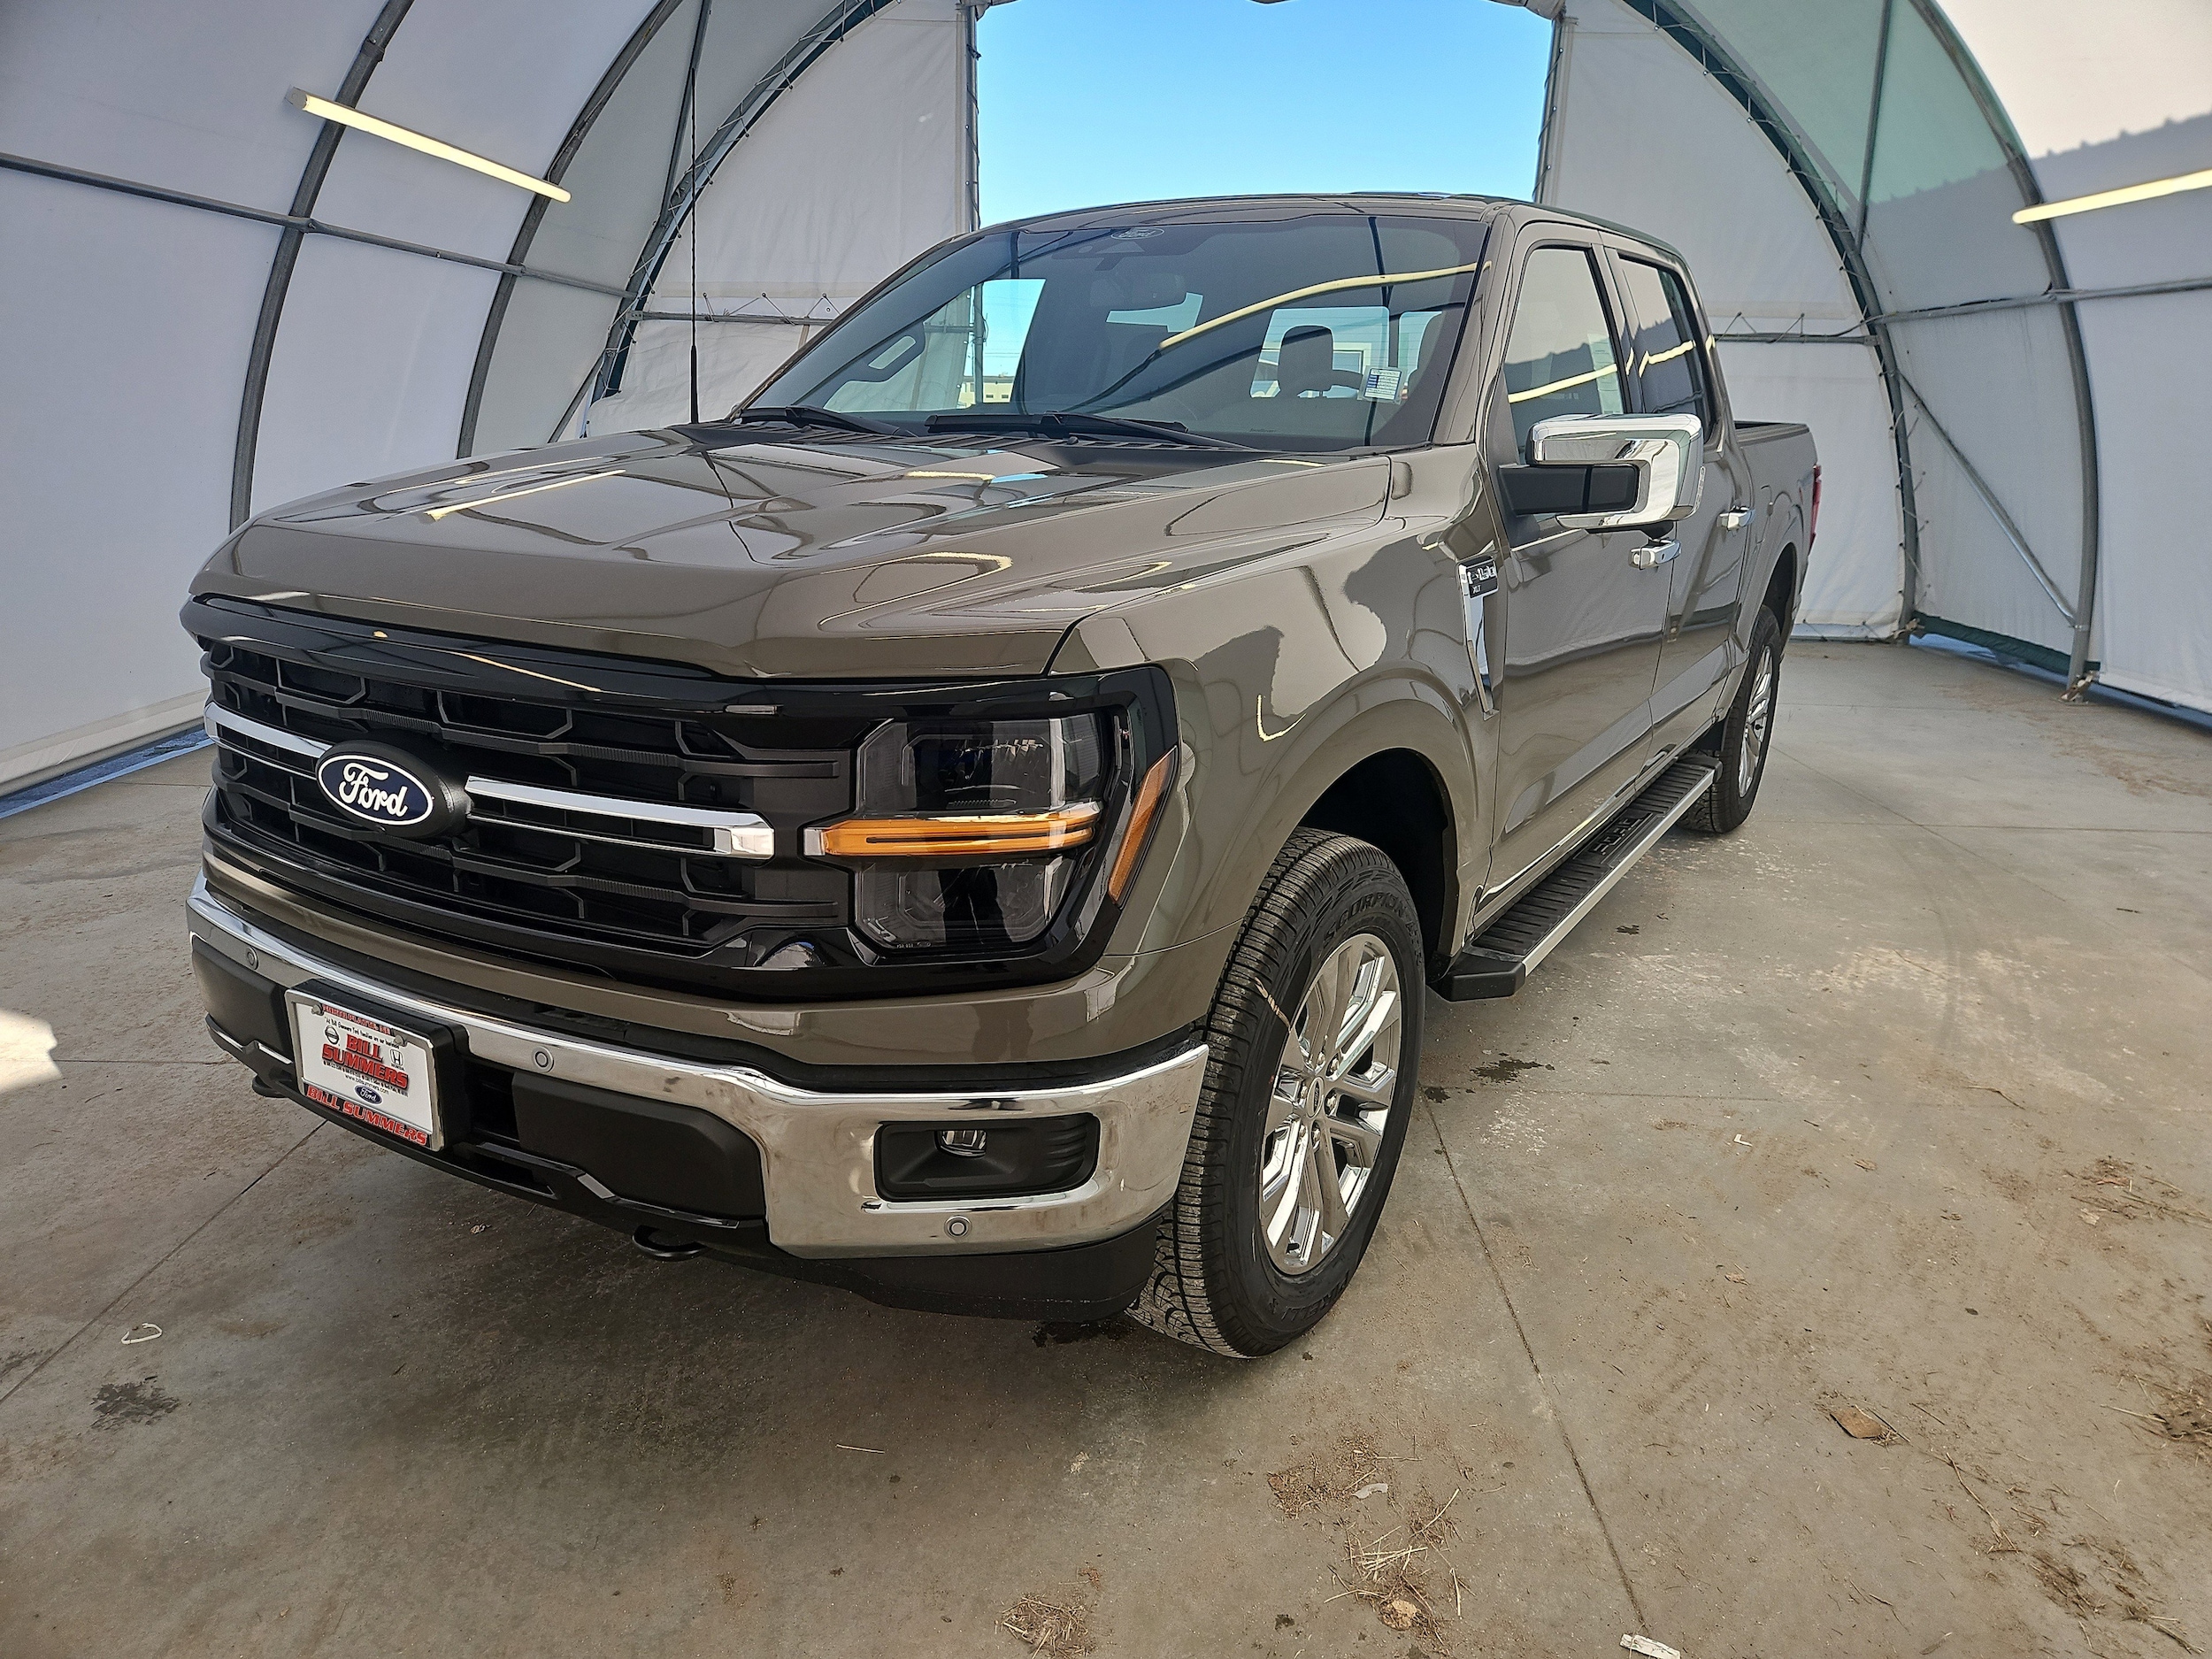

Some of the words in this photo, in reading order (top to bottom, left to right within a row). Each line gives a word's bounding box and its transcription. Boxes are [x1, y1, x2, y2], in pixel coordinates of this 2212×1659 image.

[1472, 585, 1481, 594] XLT
[338, 762, 409, 818] Ford
[322, 1043, 409, 1089] SUMMERS
[346, 1033, 383, 1062] BILL
[359, 1087, 378, 1102] Ford
[306, 1085, 340, 1110] BILL
[343, 1101, 427, 1146] SUMMERS
